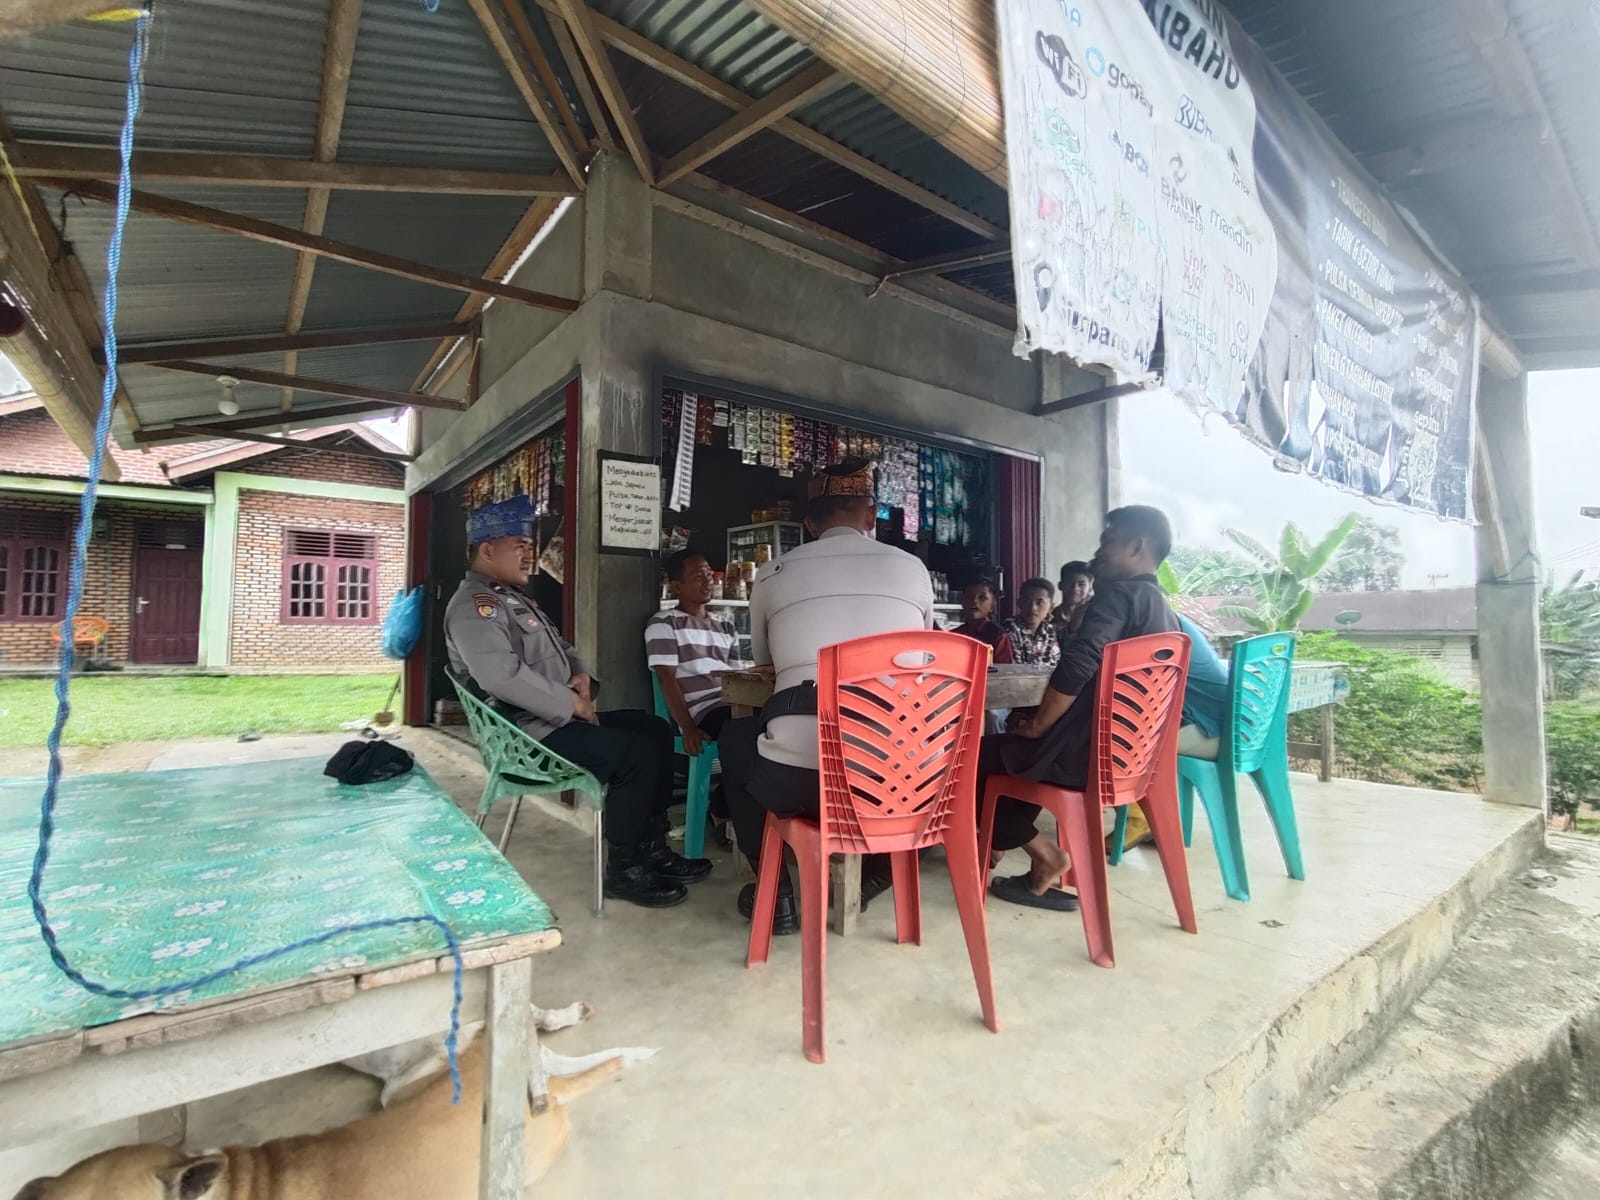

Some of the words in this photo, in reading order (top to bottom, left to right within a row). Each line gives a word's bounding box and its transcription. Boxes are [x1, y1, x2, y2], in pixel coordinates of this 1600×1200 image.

[1160, 175, 1203, 224] BANK
[1165, 196, 1205, 235] TRANSFER
[1209, 206, 1254, 257] mandiri
[1331, 217, 1355, 258] TARIK
[1358, 245, 1380, 280] SETOR
[1234, 272, 1256, 306] BNI
[1325, 259, 1349, 296] PULSA
[1321, 298, 1348, 334] PAKET
